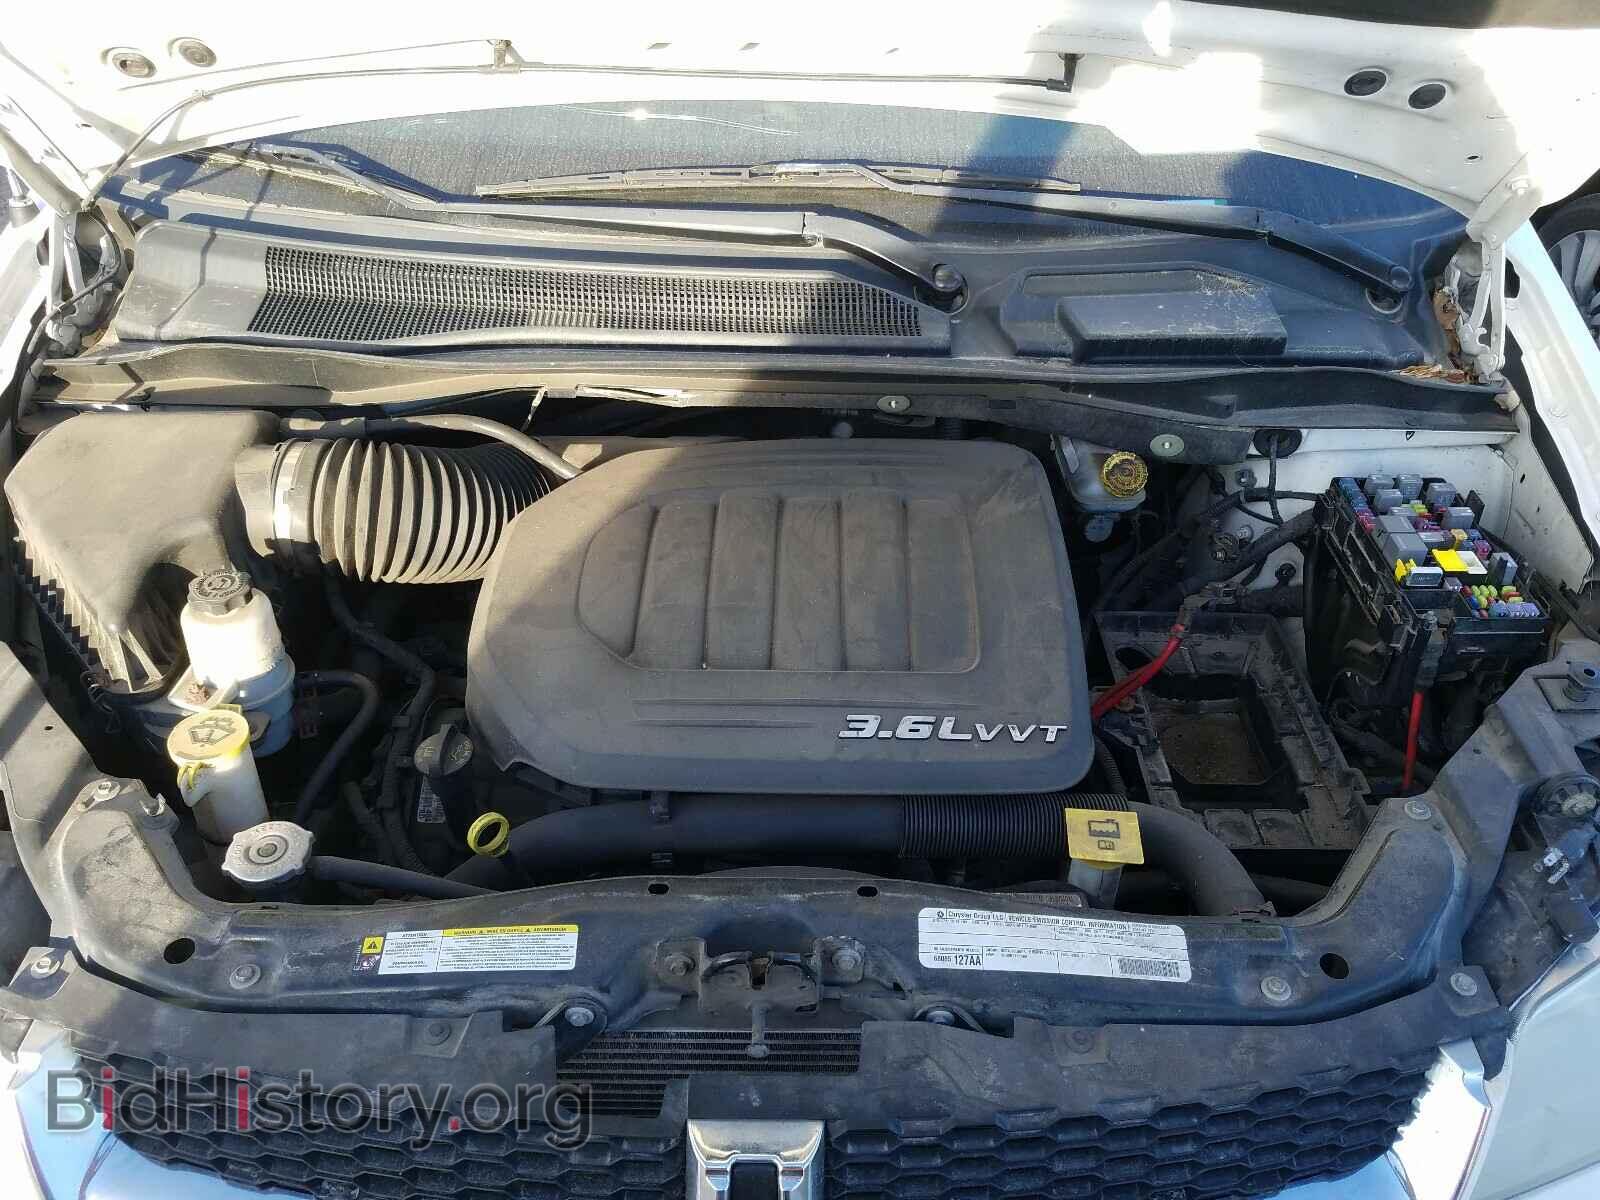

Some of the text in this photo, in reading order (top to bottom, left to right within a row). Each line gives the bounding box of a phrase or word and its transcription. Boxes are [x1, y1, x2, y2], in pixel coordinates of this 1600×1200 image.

[1008, 915, 1032, 923] VEHICLE
[1061, 919, 1087, 928] CONTROL
[1087, 921, 1128, 931] INFORMATION
[954, 954, 982, 966] 127AA
